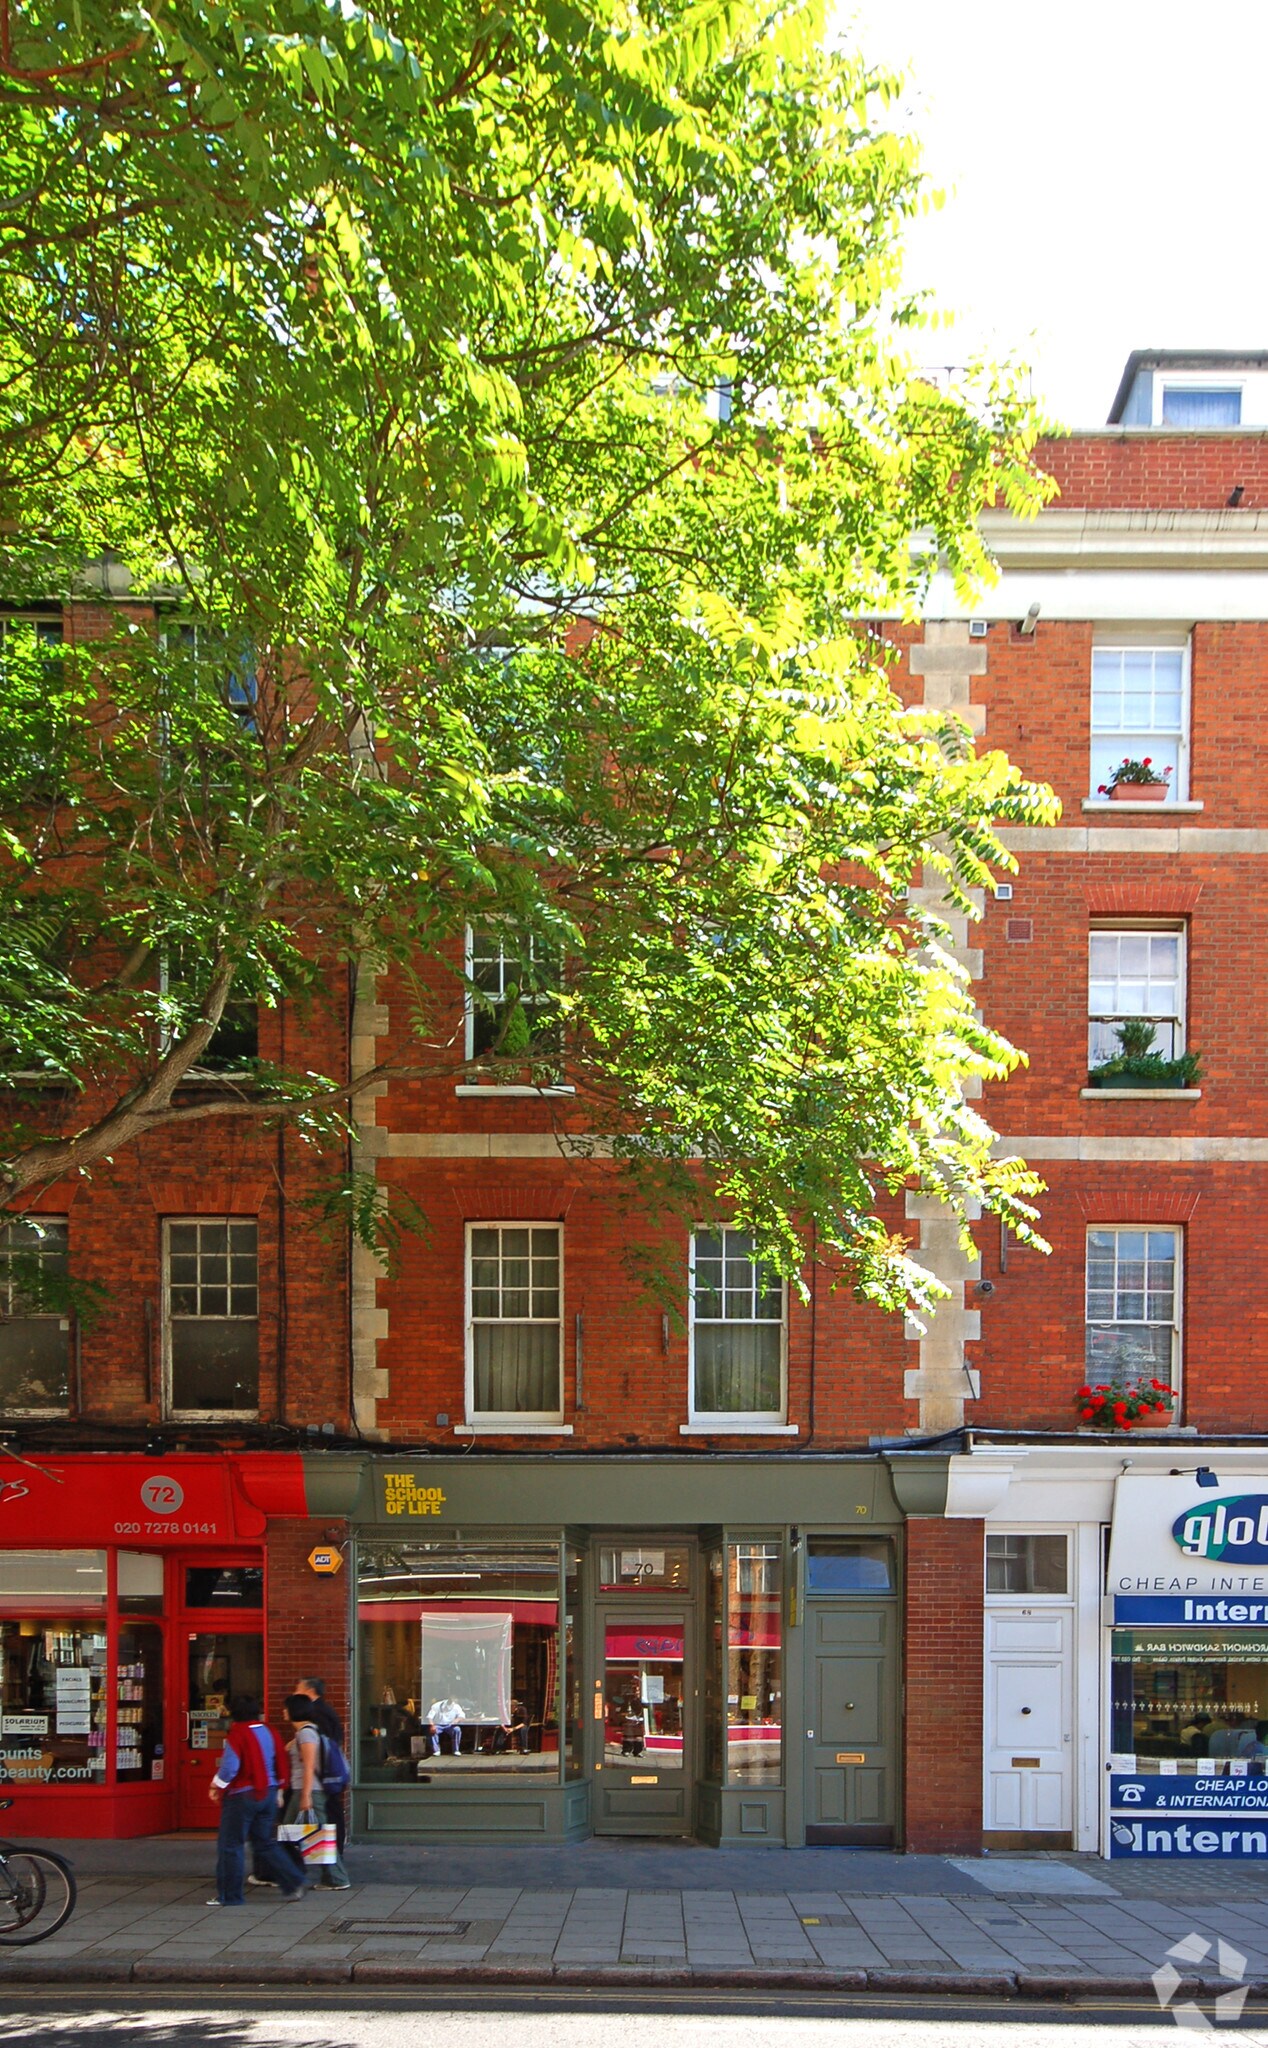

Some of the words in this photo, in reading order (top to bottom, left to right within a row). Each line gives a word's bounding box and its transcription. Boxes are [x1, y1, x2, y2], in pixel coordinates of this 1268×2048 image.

[384, 1474, 415, 1487] THE
[148, 1486, 176, 1503] 72
[385, 1487, 447, 1501] SCHOOL
[386, 1501, 406, 1515] OF
[408, 1501, 441, 1515] LIFE
[855, 1505, 867, 1515] 70
[114, 1522, 141, 1534] 020
[144, 1522, 180, 1534] 7278
[183, 1522, 217, 1534] 0141
[315, 1555, 331, 1564] ADT
[634, 1563, 654, 1575] 70
[1119, 1577, 1198, 1590] CHEAP
[1211, 1577, 1265, 1590] INTE
[1184, 1599, 1268, 1621] Inter
[1195, 1780, 1246, 1791] CHEAP
[1156, 1795, 1166, 1806] &
[1131, 1823, 1267, 1853] Intern
